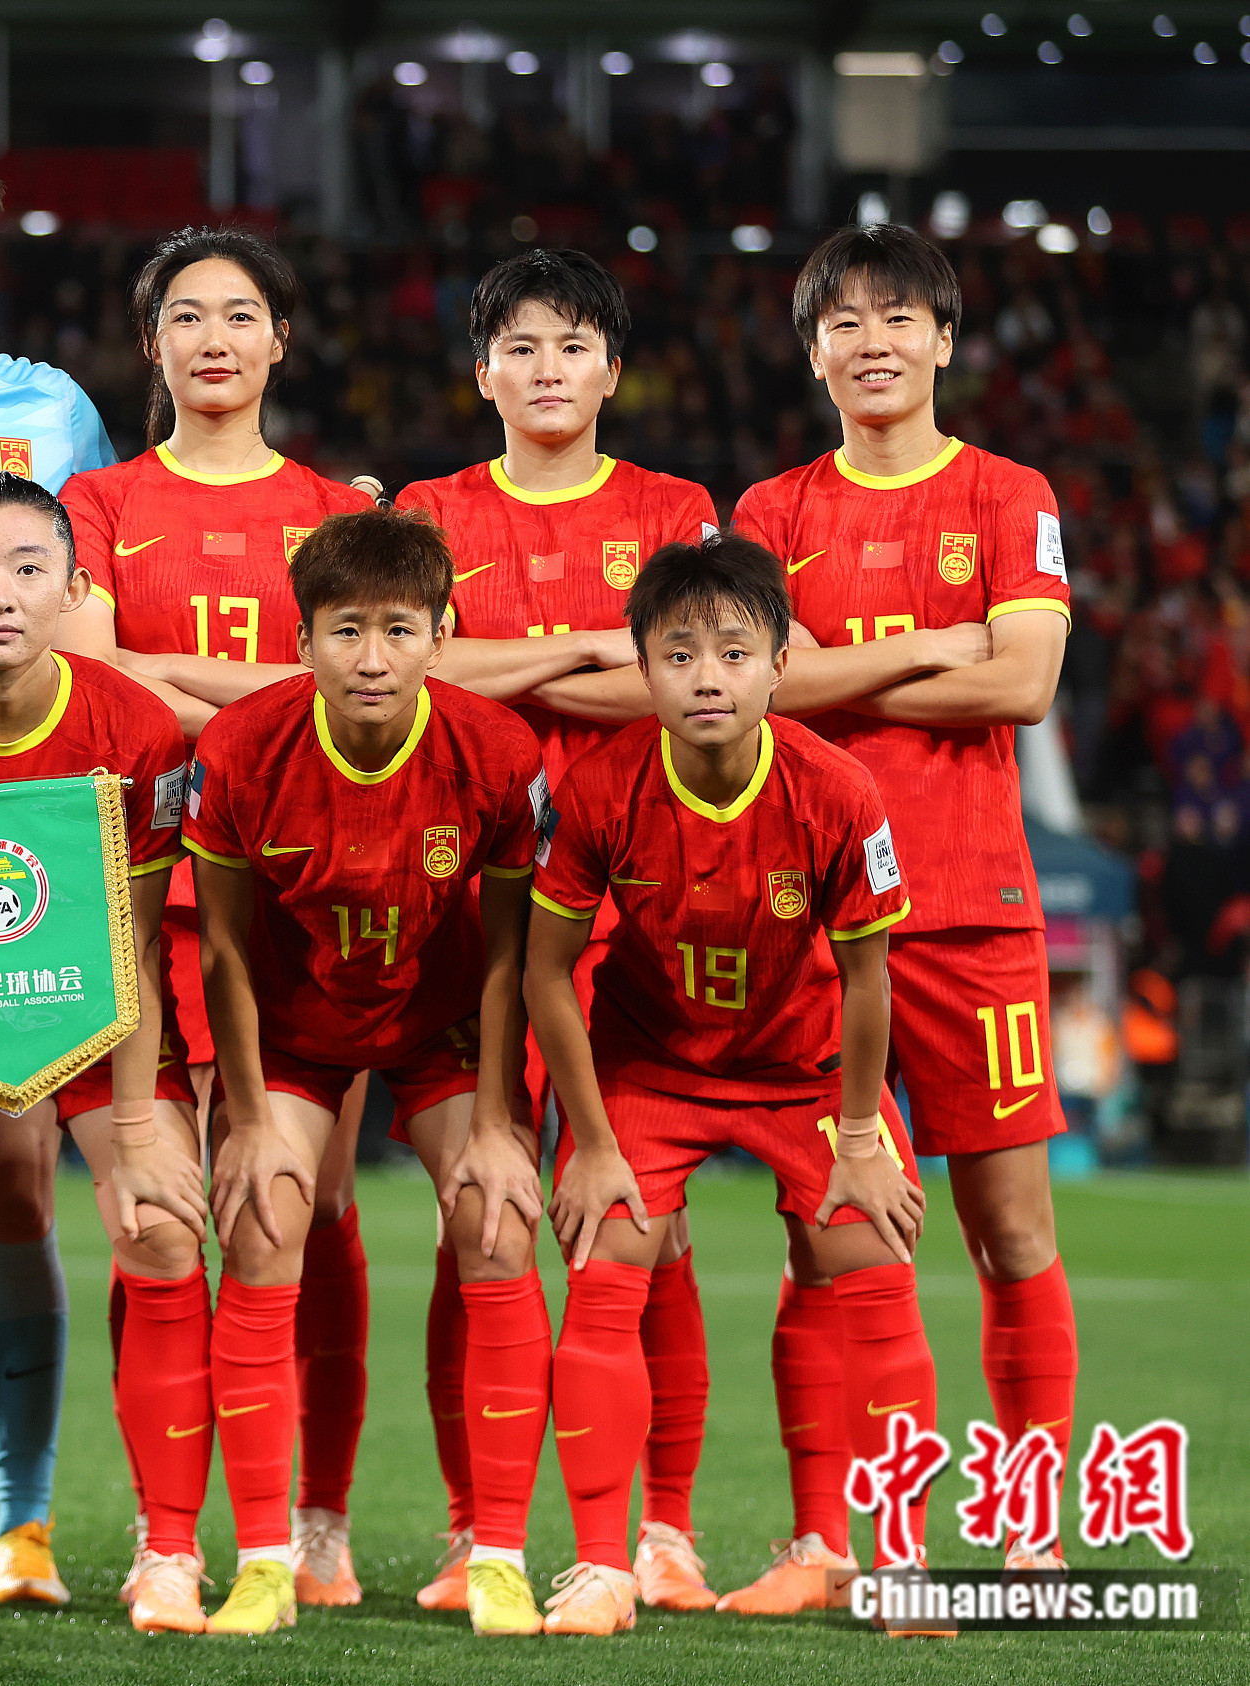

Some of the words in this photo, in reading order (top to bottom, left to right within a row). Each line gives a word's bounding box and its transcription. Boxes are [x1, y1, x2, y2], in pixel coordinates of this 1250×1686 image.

[0, 441, 27, 453] CFA
[944, 535, 974, 548] CFA
[606, 544, 636, 554] CFA
[190, 594, 260, 664] 13
[426, 829, 456, 841] CFA
[771, 873, 802, 885] CFA
[331, 905, 399, 966] 14
[676, 942, 747, 1010] 19
[23, 993, 85, 1006] ASSOCIATION
[976, 1000, 1045, 1090] 10
